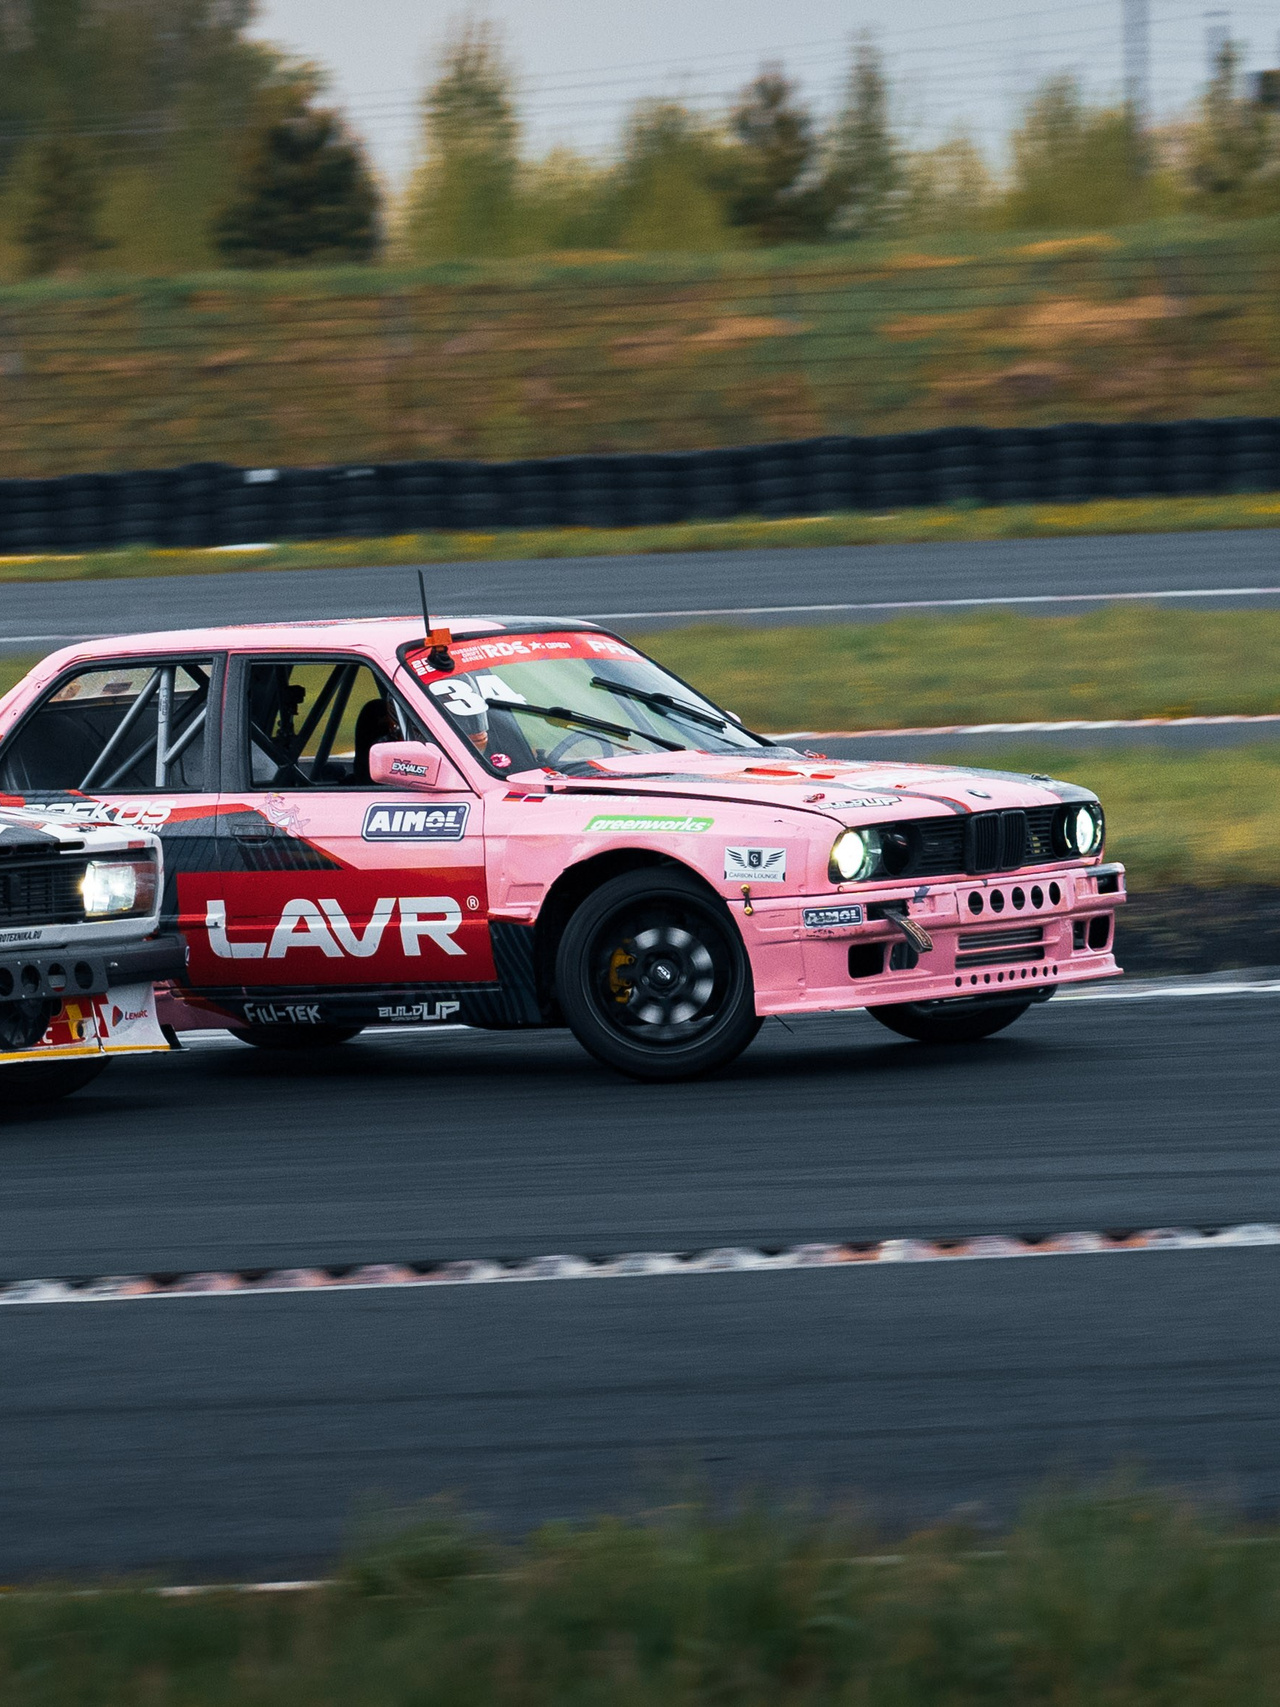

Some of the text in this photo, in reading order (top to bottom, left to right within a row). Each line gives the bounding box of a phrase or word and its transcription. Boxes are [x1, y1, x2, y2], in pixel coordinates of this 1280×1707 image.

[481, 641, 531, 658] RDS
[429, 675, 527, 716] 34
[391, 761, 429, 775] EXHAUST
[367, 810, 462, 833] AIMOL
[587, 817, 707, 832] greenworks
[205, 896, 468, 959] LAVR
[377, 1001, 460, 1020] BUILD UP
